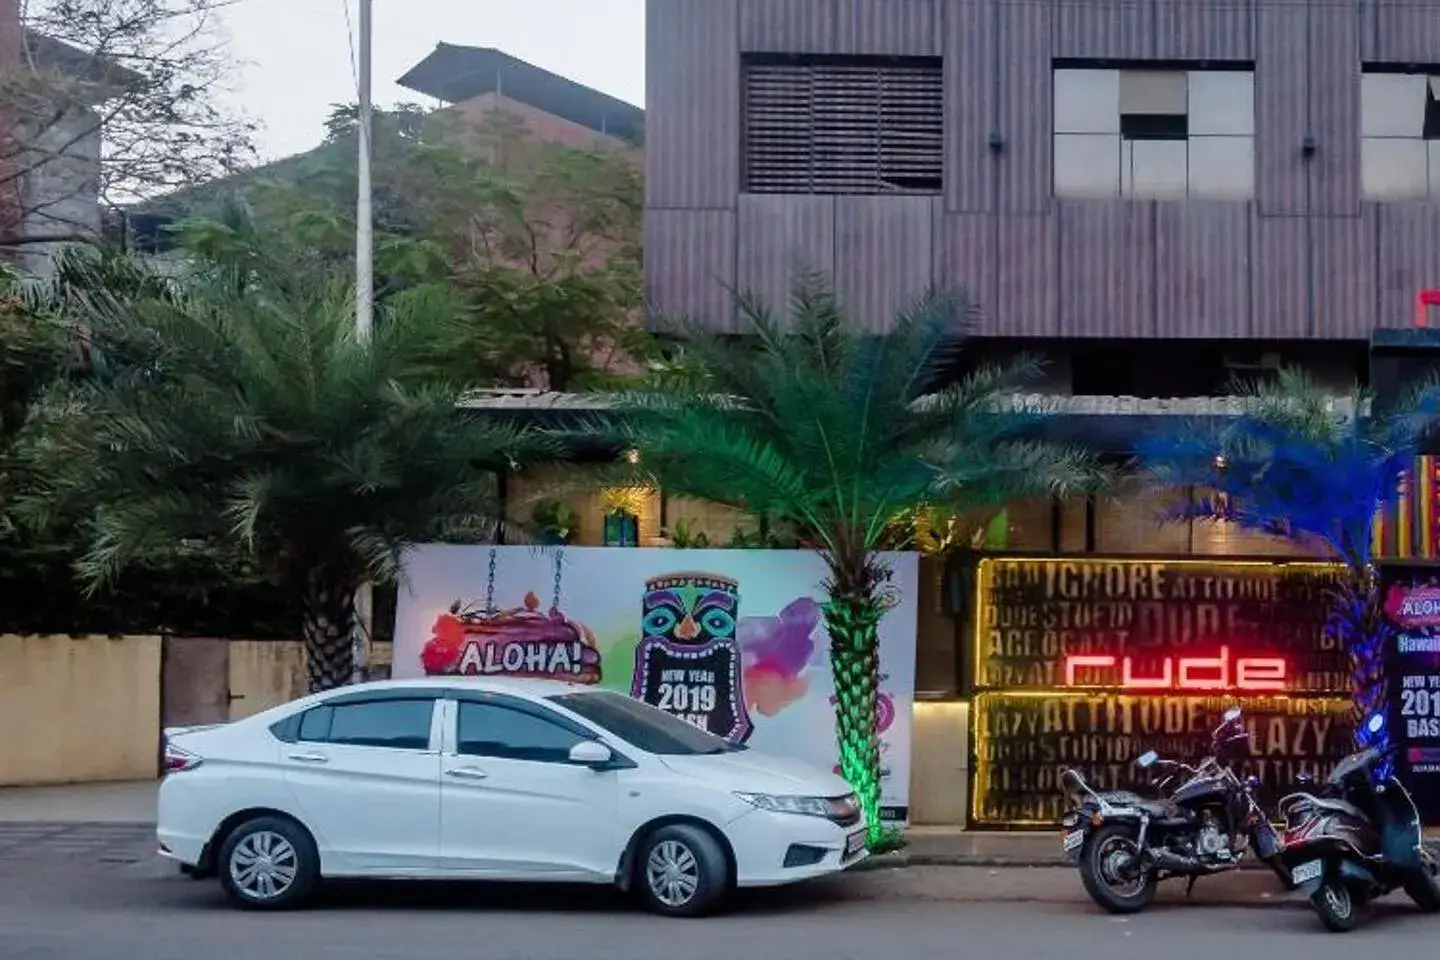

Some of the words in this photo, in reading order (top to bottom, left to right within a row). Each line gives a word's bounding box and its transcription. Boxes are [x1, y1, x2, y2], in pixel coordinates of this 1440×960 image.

[1046, 563, 1167, 599] IGNORE
[460, 641, 582, 674] ALOHA!
[1066, 644, 1286, 689] rude
[661, 669, 685, 682] NEW
[689, 670, 715, 683] YEAR
[1403, 675, 1426, 688] NEW
[658, 683, 716, 711] 2019
[1043, 696, 1203, 734] ATTITUDE
[1248, 716, 1333, 757] LAZY
